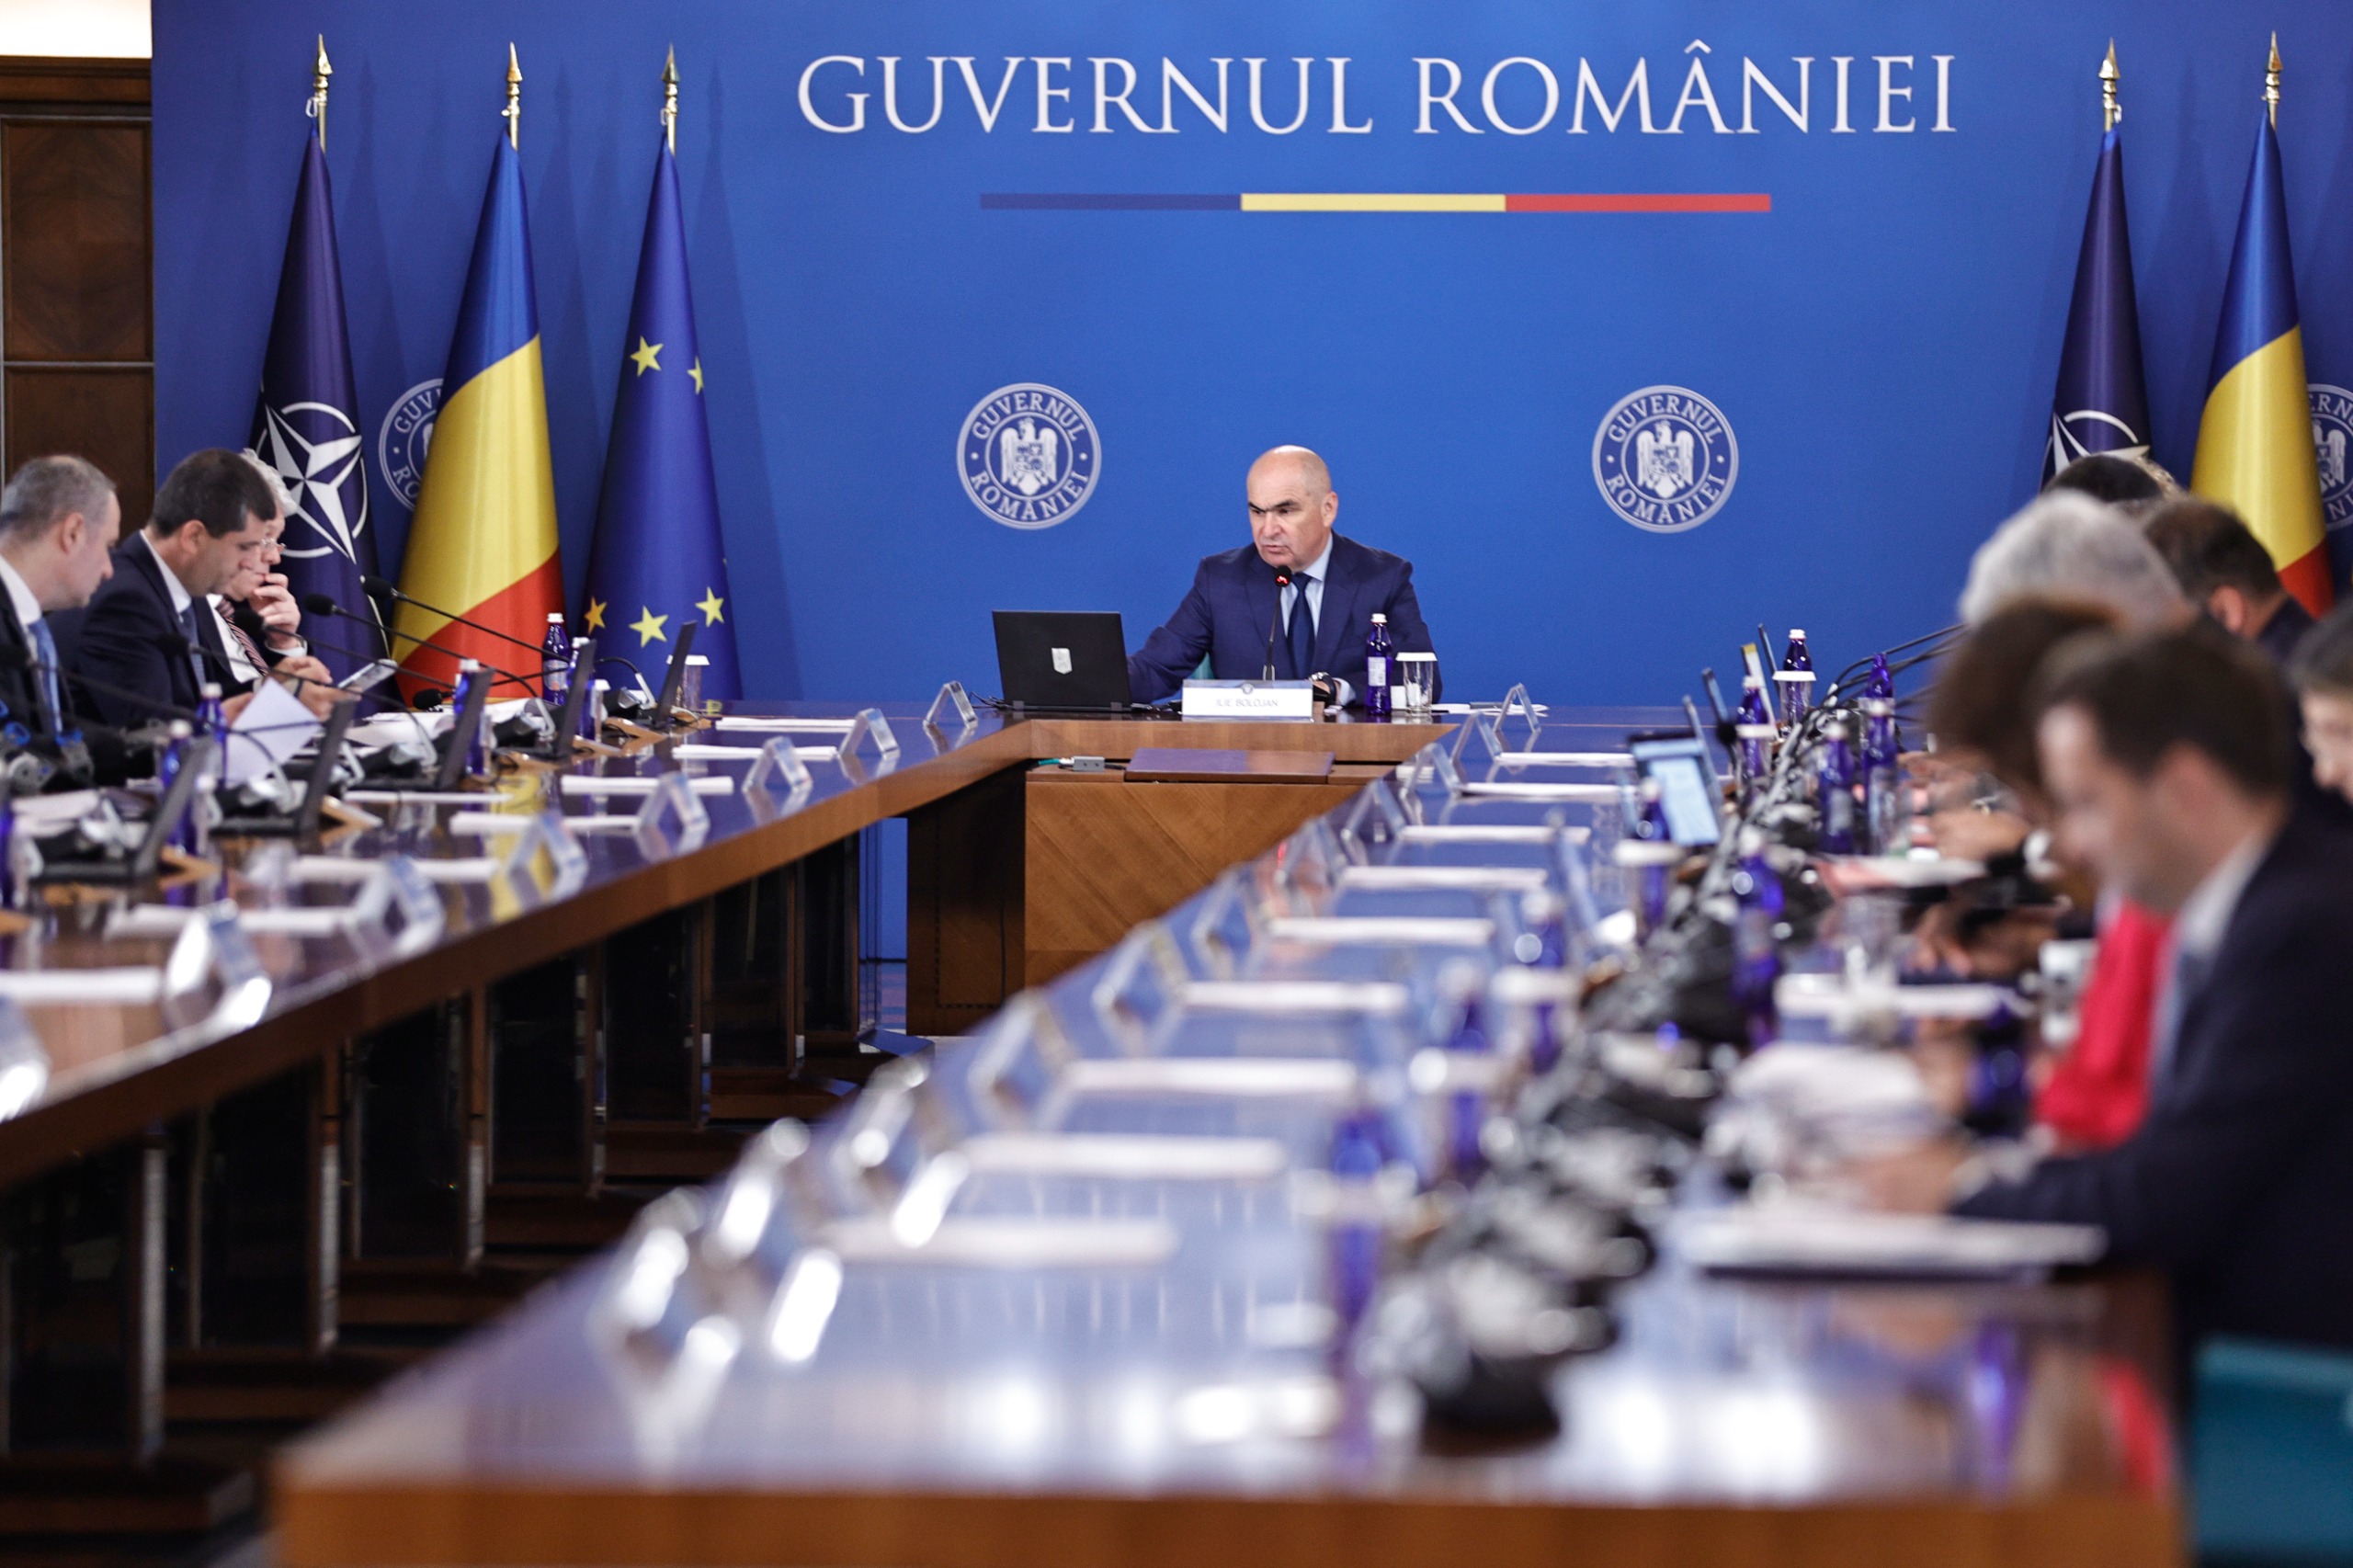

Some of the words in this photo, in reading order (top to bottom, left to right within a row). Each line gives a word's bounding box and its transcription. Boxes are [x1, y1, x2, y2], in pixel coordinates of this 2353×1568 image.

[798, 54, 1373, 135] GUVERNUL
[1412, 39, 1957, 136] ROMÂNIEI
[972, 392, 1086, 441] GUVERNUL
[1608, 395, 1722, 444] GUVERNUL
[972, 471, 1088, 520] ROMÂNIEI
[1607, 473, 1725, 524] ROMÂNIEI
